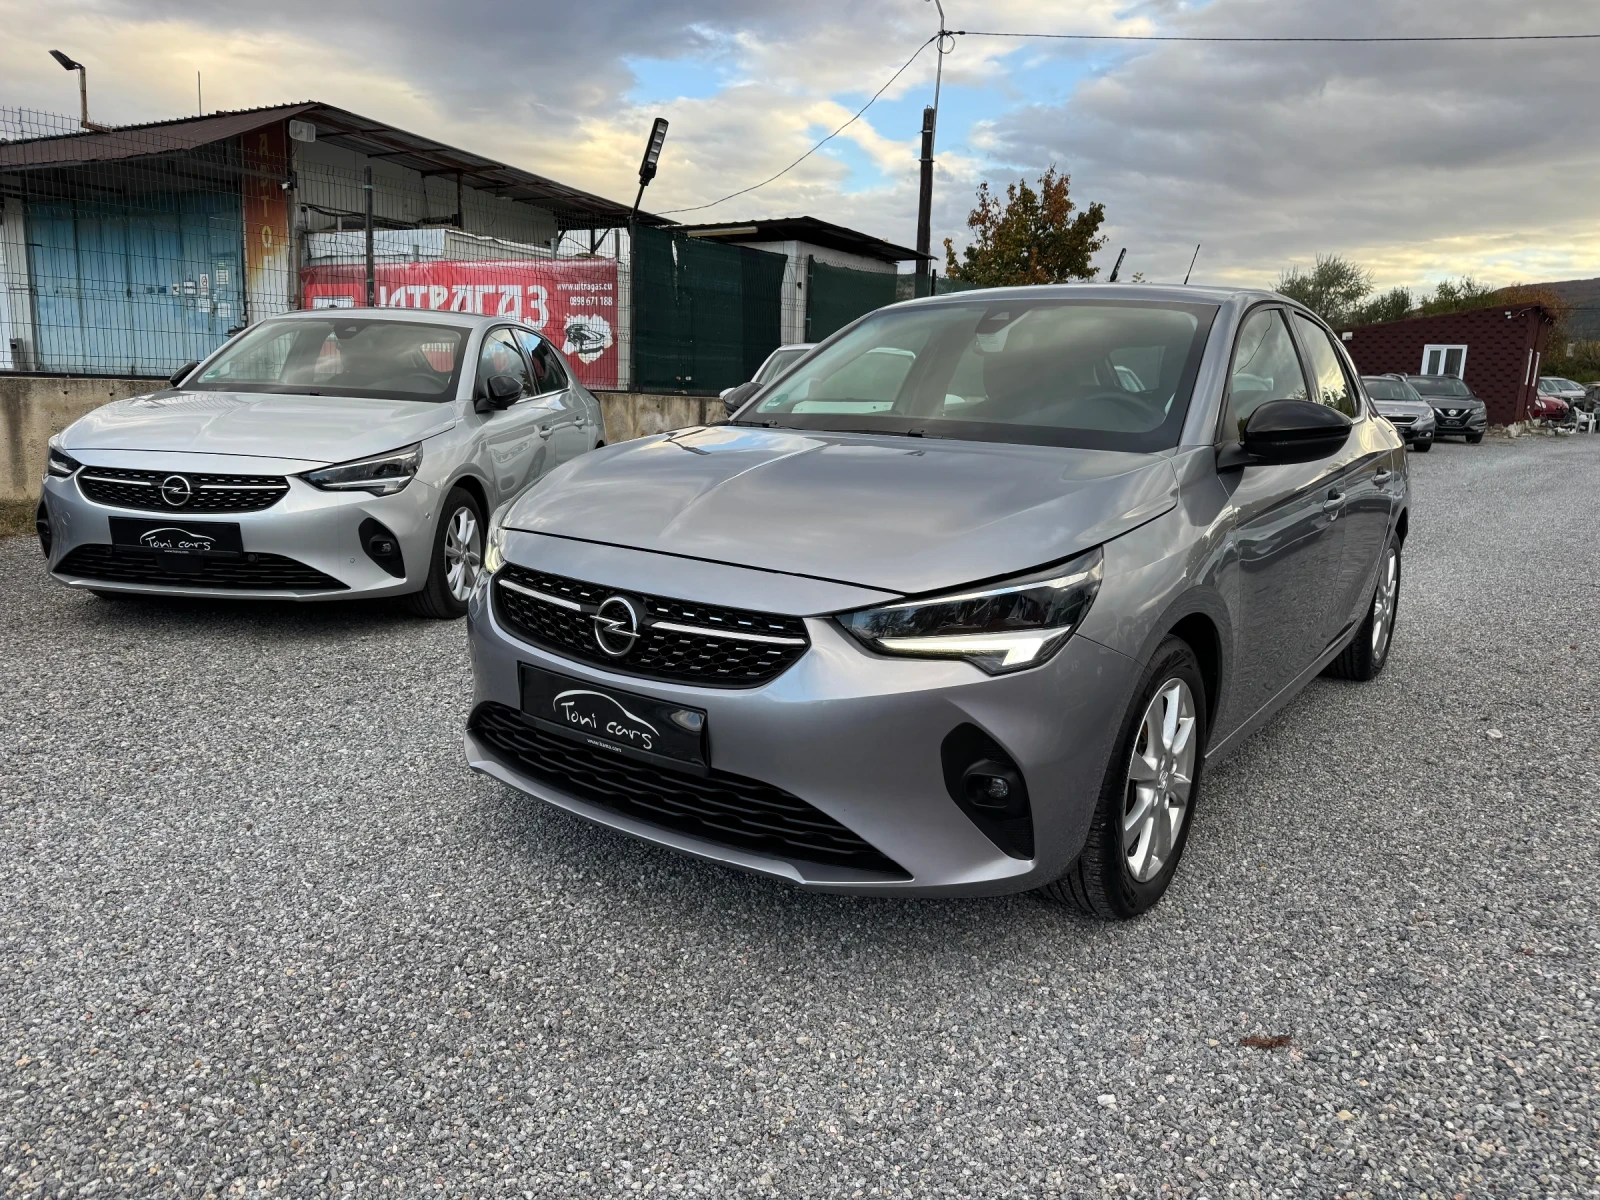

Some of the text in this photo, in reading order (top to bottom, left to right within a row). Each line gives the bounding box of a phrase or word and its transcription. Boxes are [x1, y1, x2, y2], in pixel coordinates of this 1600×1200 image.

[570, 296, 613, 306] 0898 671 188
[145, 535, 211, 551] Toni cars
[561, 701, 653, 750] Toni cars
